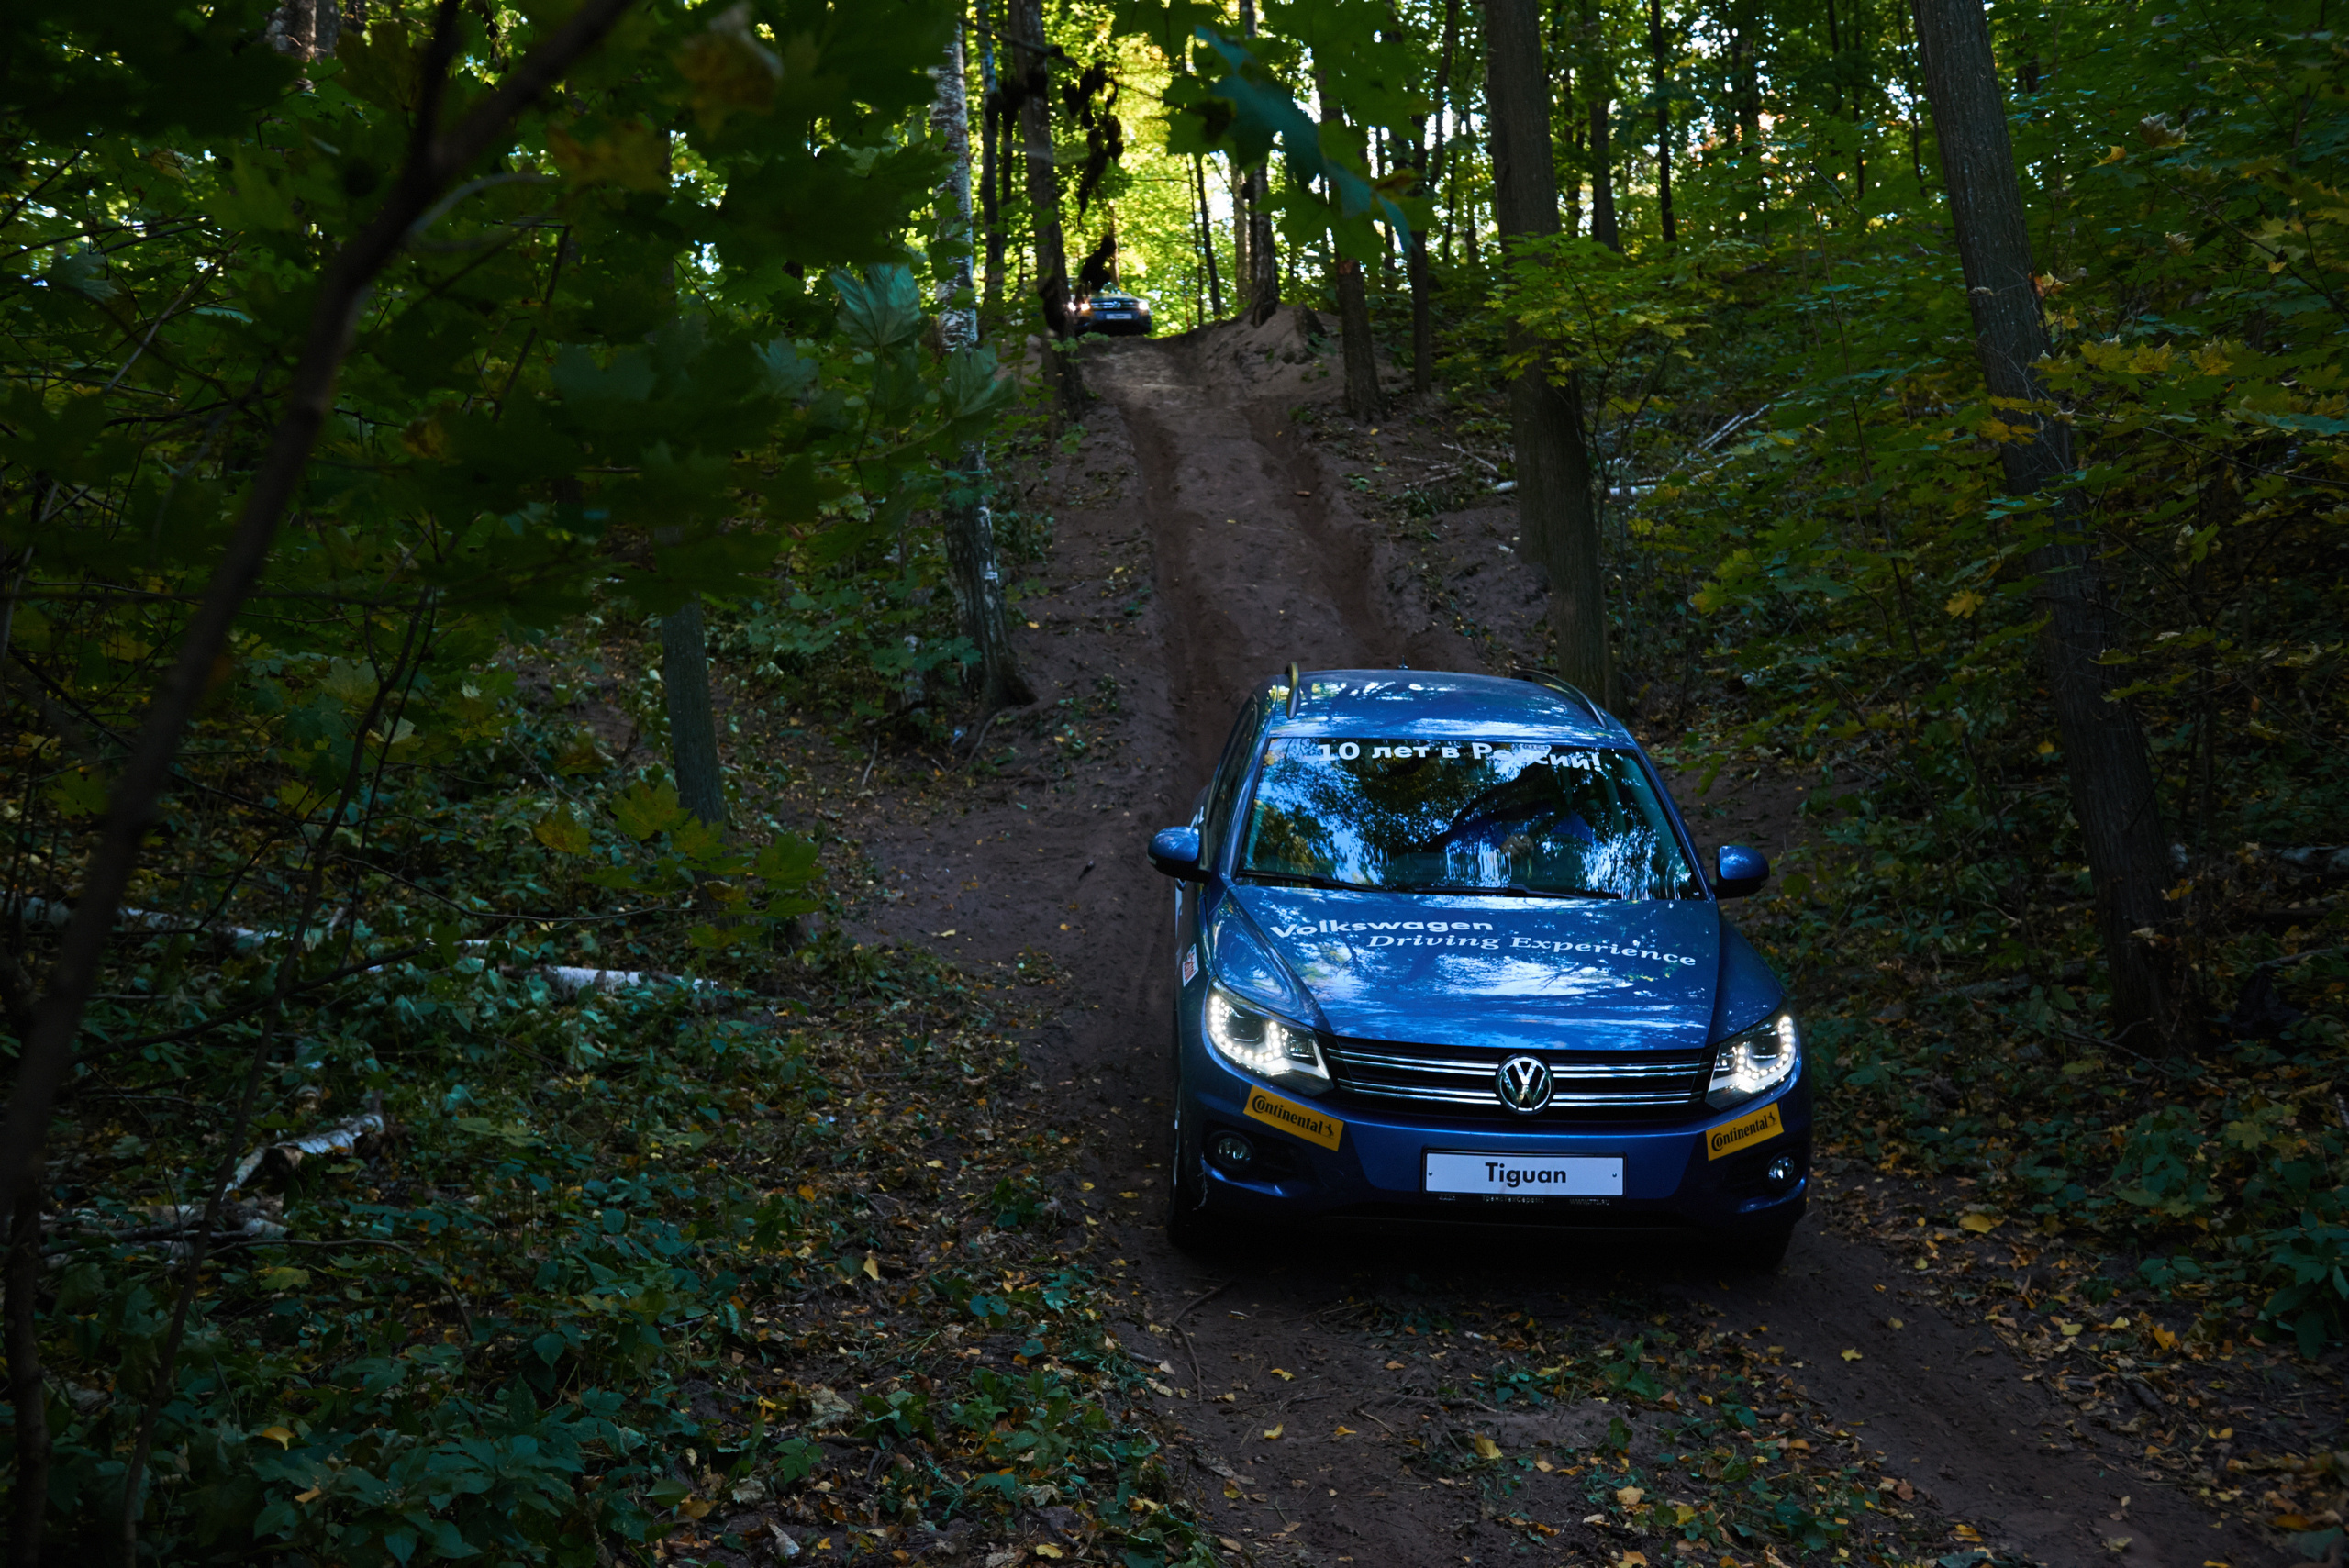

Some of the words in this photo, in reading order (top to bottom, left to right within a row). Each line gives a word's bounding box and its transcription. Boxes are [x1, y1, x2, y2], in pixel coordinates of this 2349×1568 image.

[1318, 742, 1360, 761] 10
[1372, 746, 1430, 759] лет
[1442, 747, 1460, 759] в
[1270, 920, 1494, 938] Volkswagen
[1366, 935, 1500, 950] Driving
[1509, 937, 1697, 965] Experience
[1252, 1095, 1323, 1134] Continental
[1711, 1115, 1768, 1151] Continental
[1485, 1162, 1566, 1188] Tiguan
